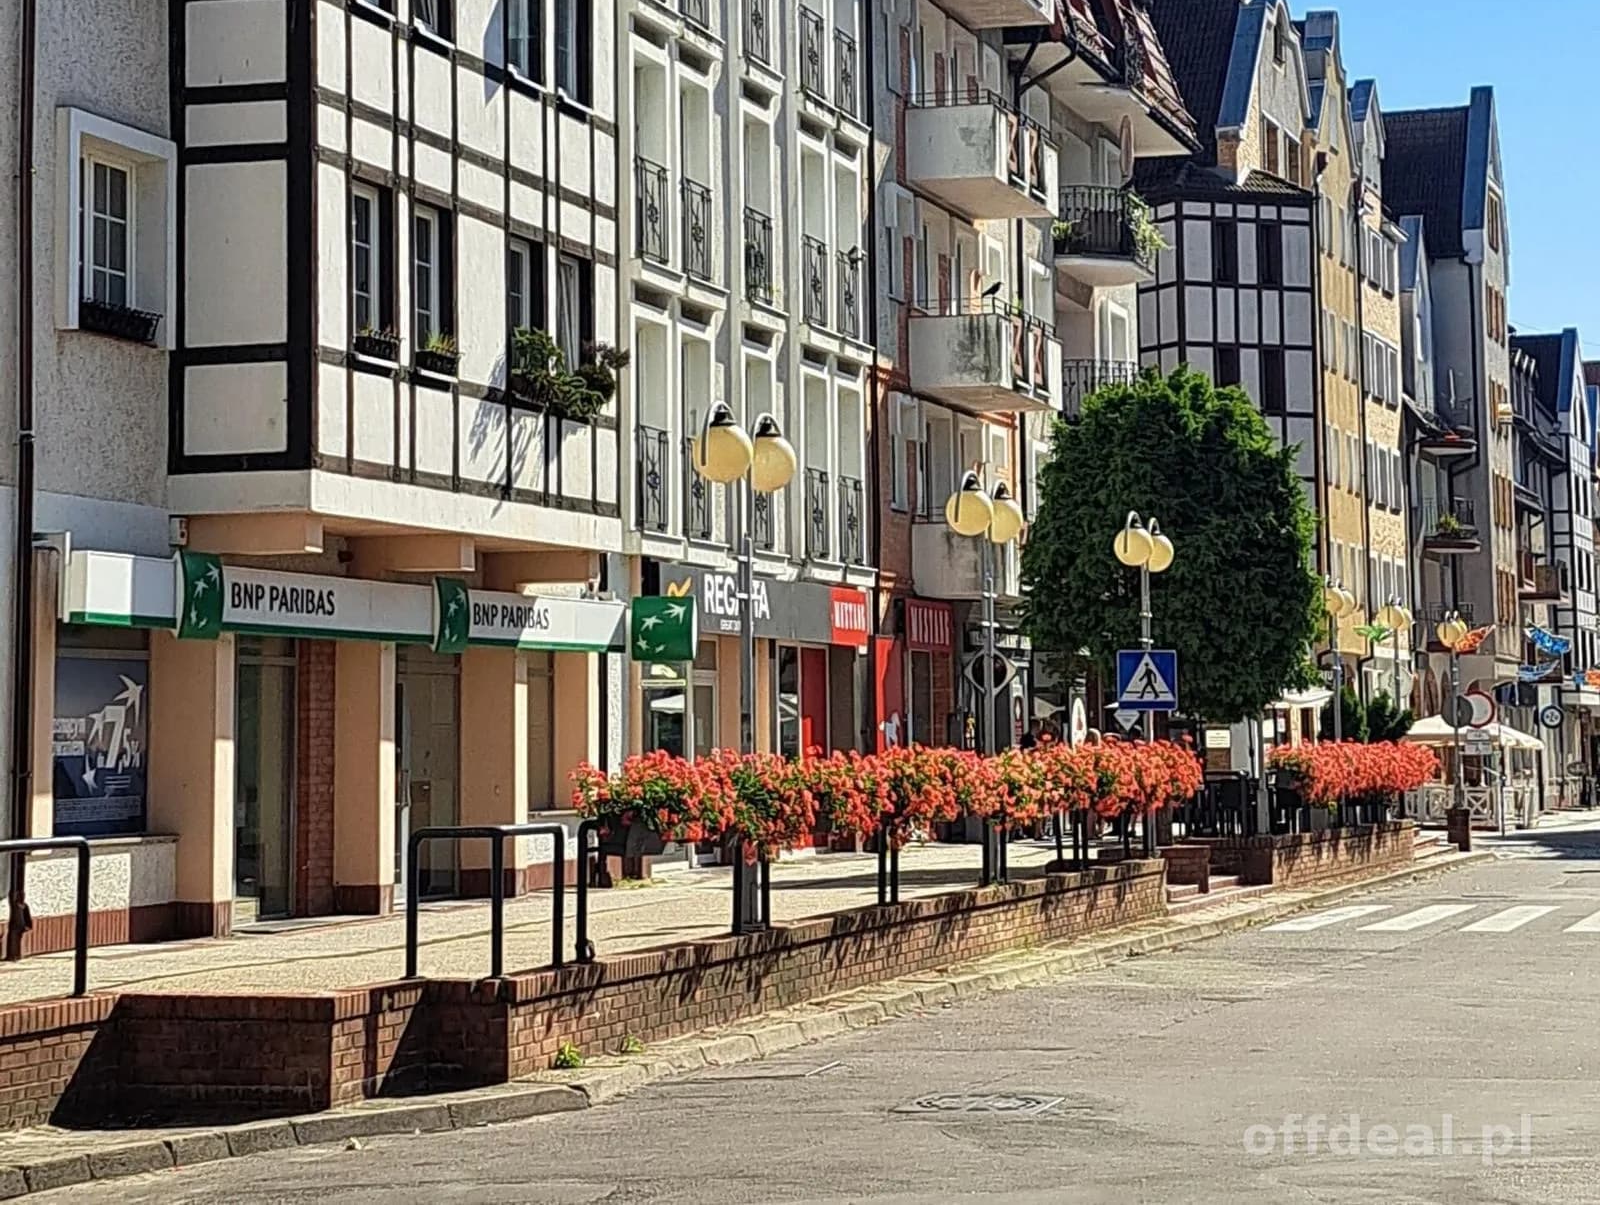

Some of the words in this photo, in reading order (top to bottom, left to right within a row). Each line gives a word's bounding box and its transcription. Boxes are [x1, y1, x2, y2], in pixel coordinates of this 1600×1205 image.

[231, 582, 265, 610] BNP
[269, 585, 336, 616] PARIBAS
[704, 573, 770, 620] REGTA
[473, 602, 499, 626] BNP
[501, 604, 550, 630] PARIBAS
